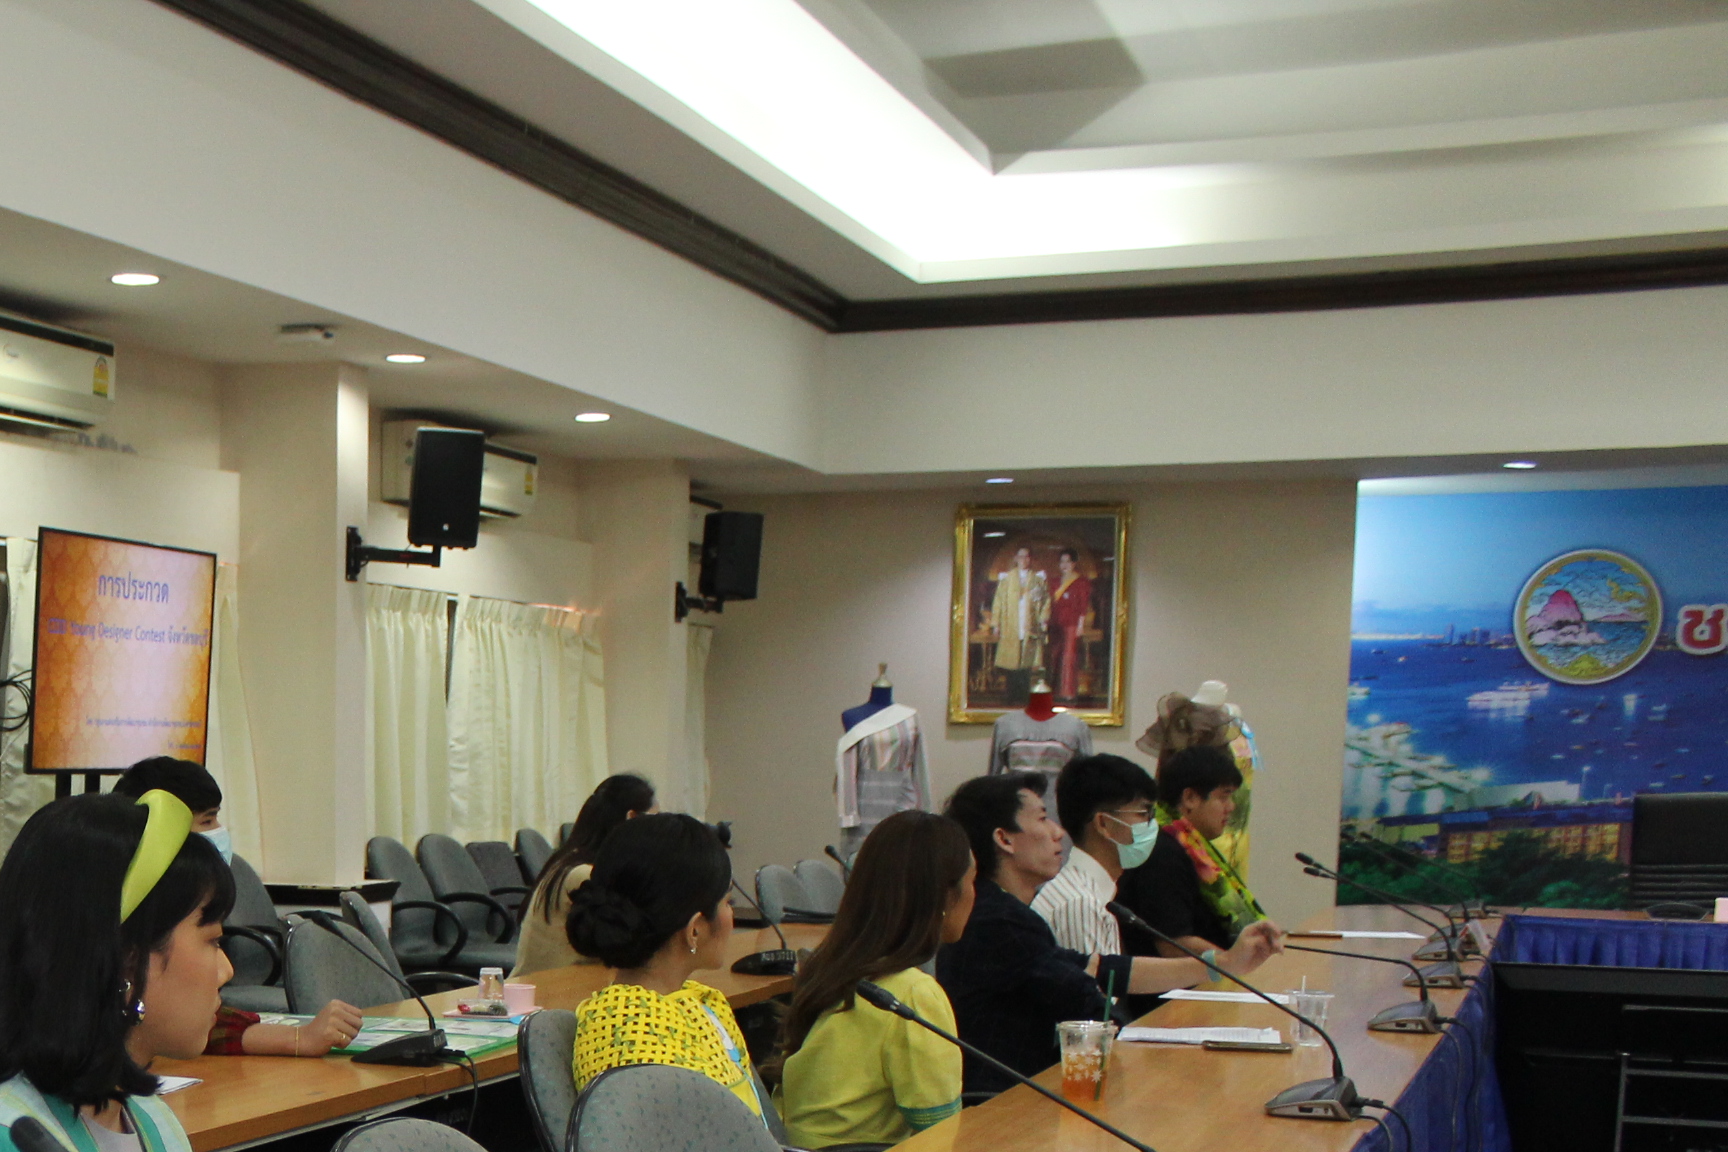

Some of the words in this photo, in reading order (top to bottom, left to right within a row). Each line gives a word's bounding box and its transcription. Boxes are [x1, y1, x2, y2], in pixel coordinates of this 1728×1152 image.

[98, 571, 169, 603] การประกวด
[99, 622, 132, 643] Designer
[135, 625, 165, 642] Contest
